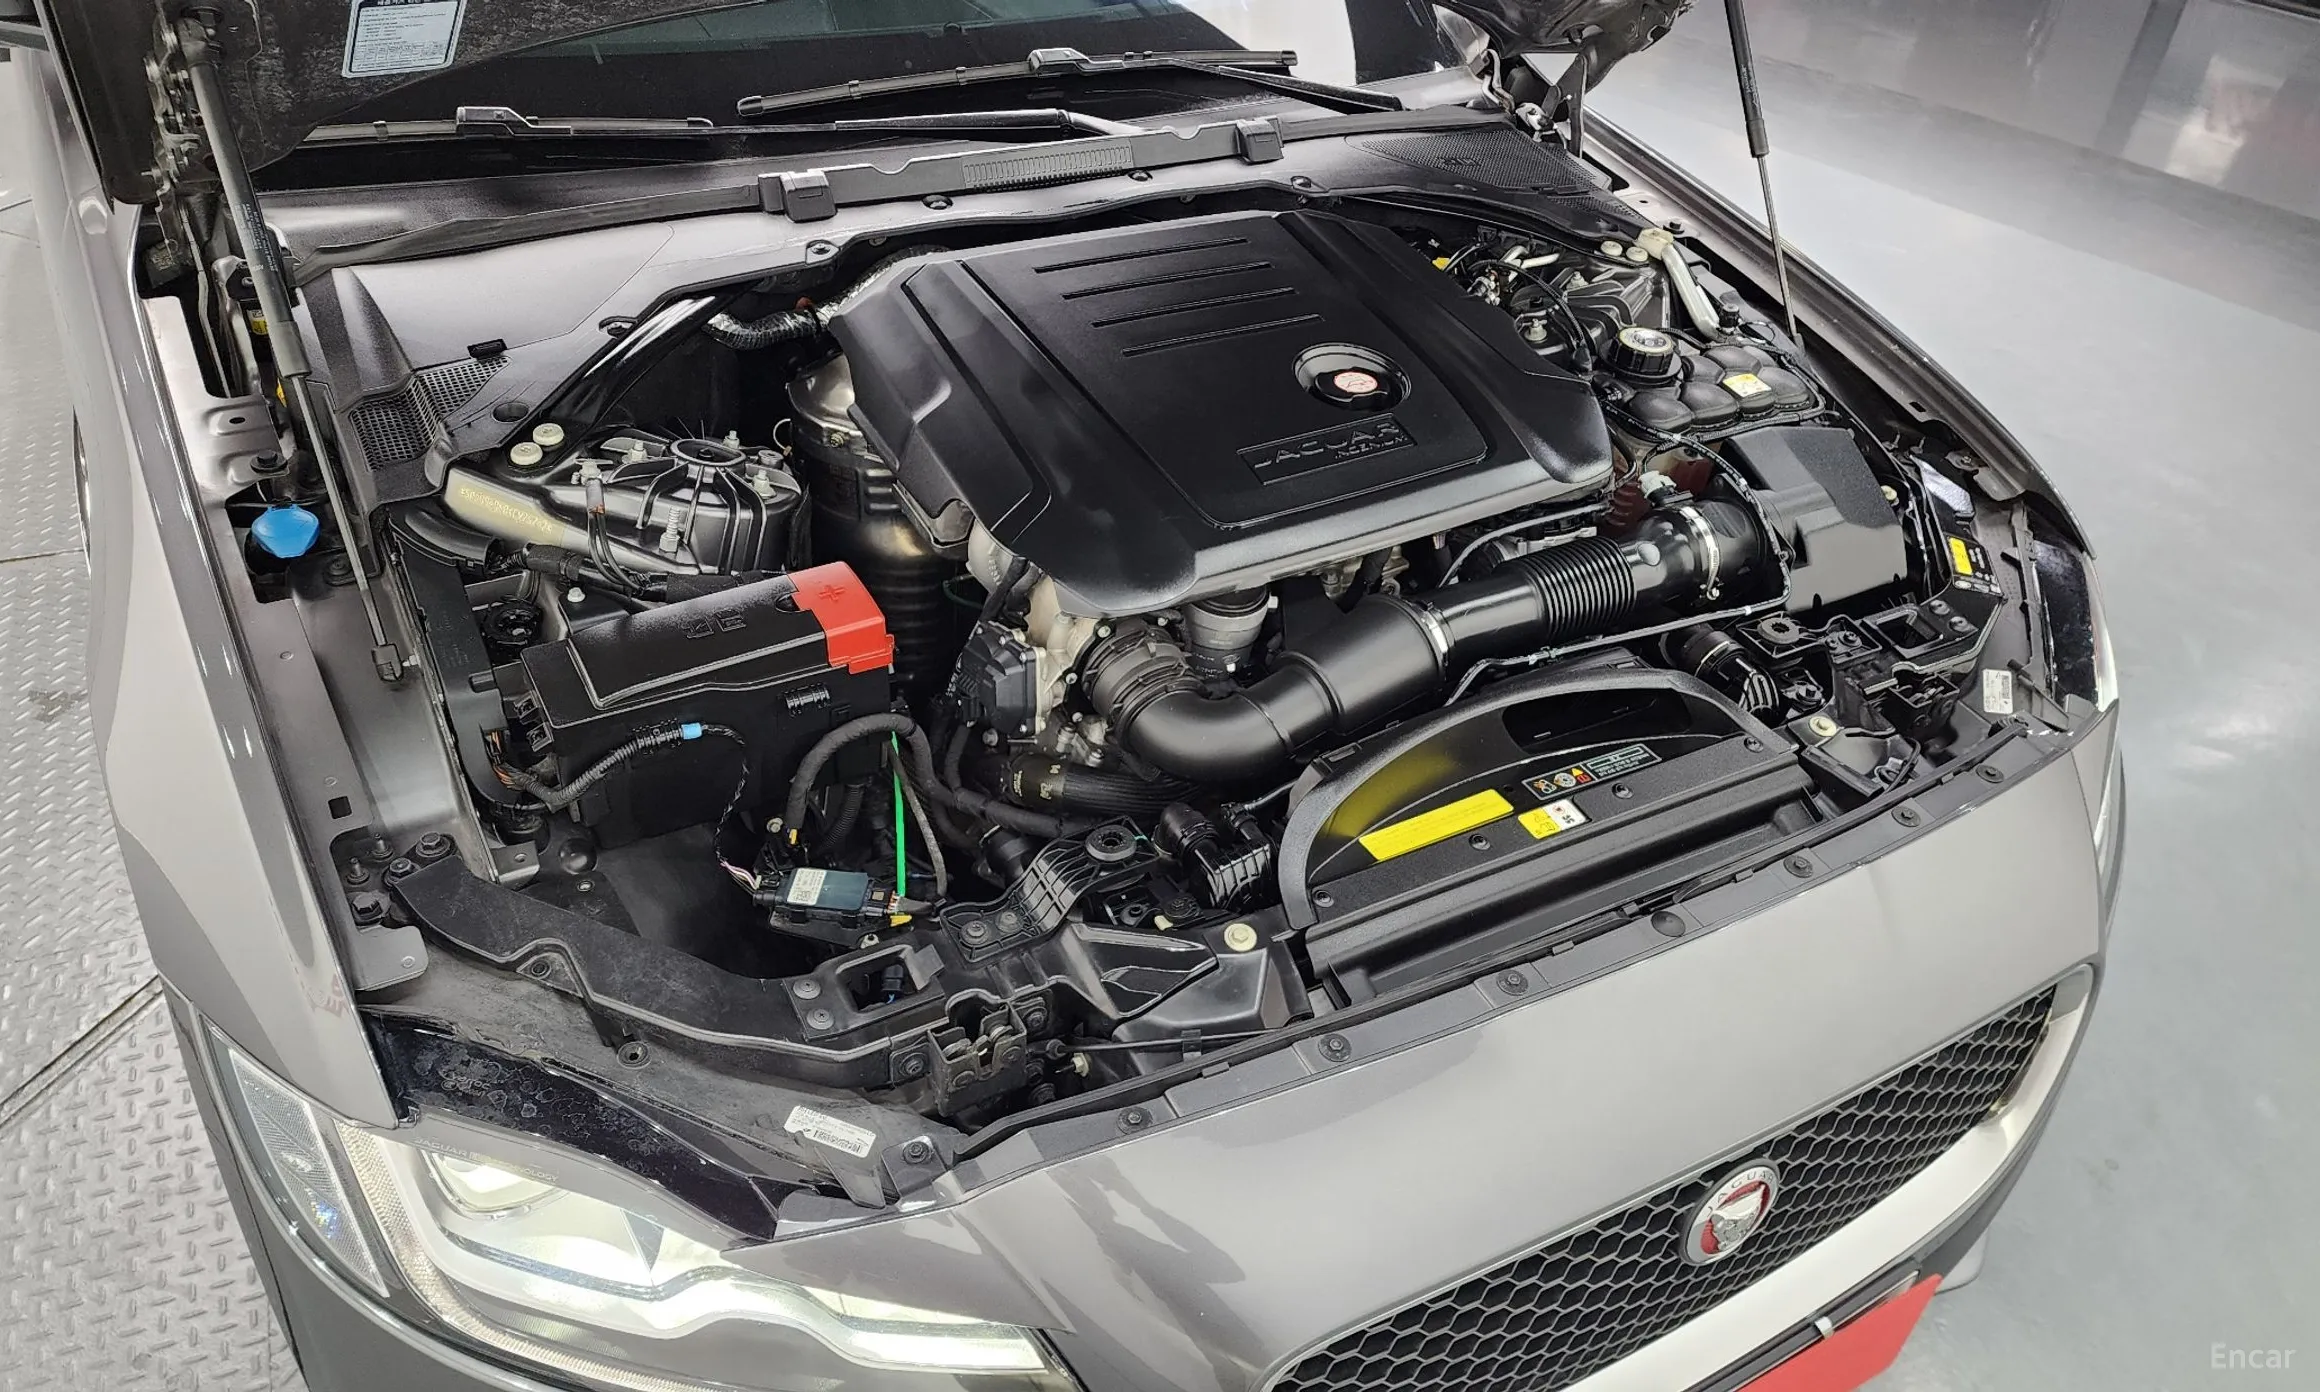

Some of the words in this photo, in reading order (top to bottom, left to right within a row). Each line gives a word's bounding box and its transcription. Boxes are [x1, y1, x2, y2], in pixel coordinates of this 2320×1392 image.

[1255, 423, 1400, 469] JAGUAR
[414, 1138, 469, 1157] JAGUAR
[1707, 1171, 1774, 1217] JAGUAR
